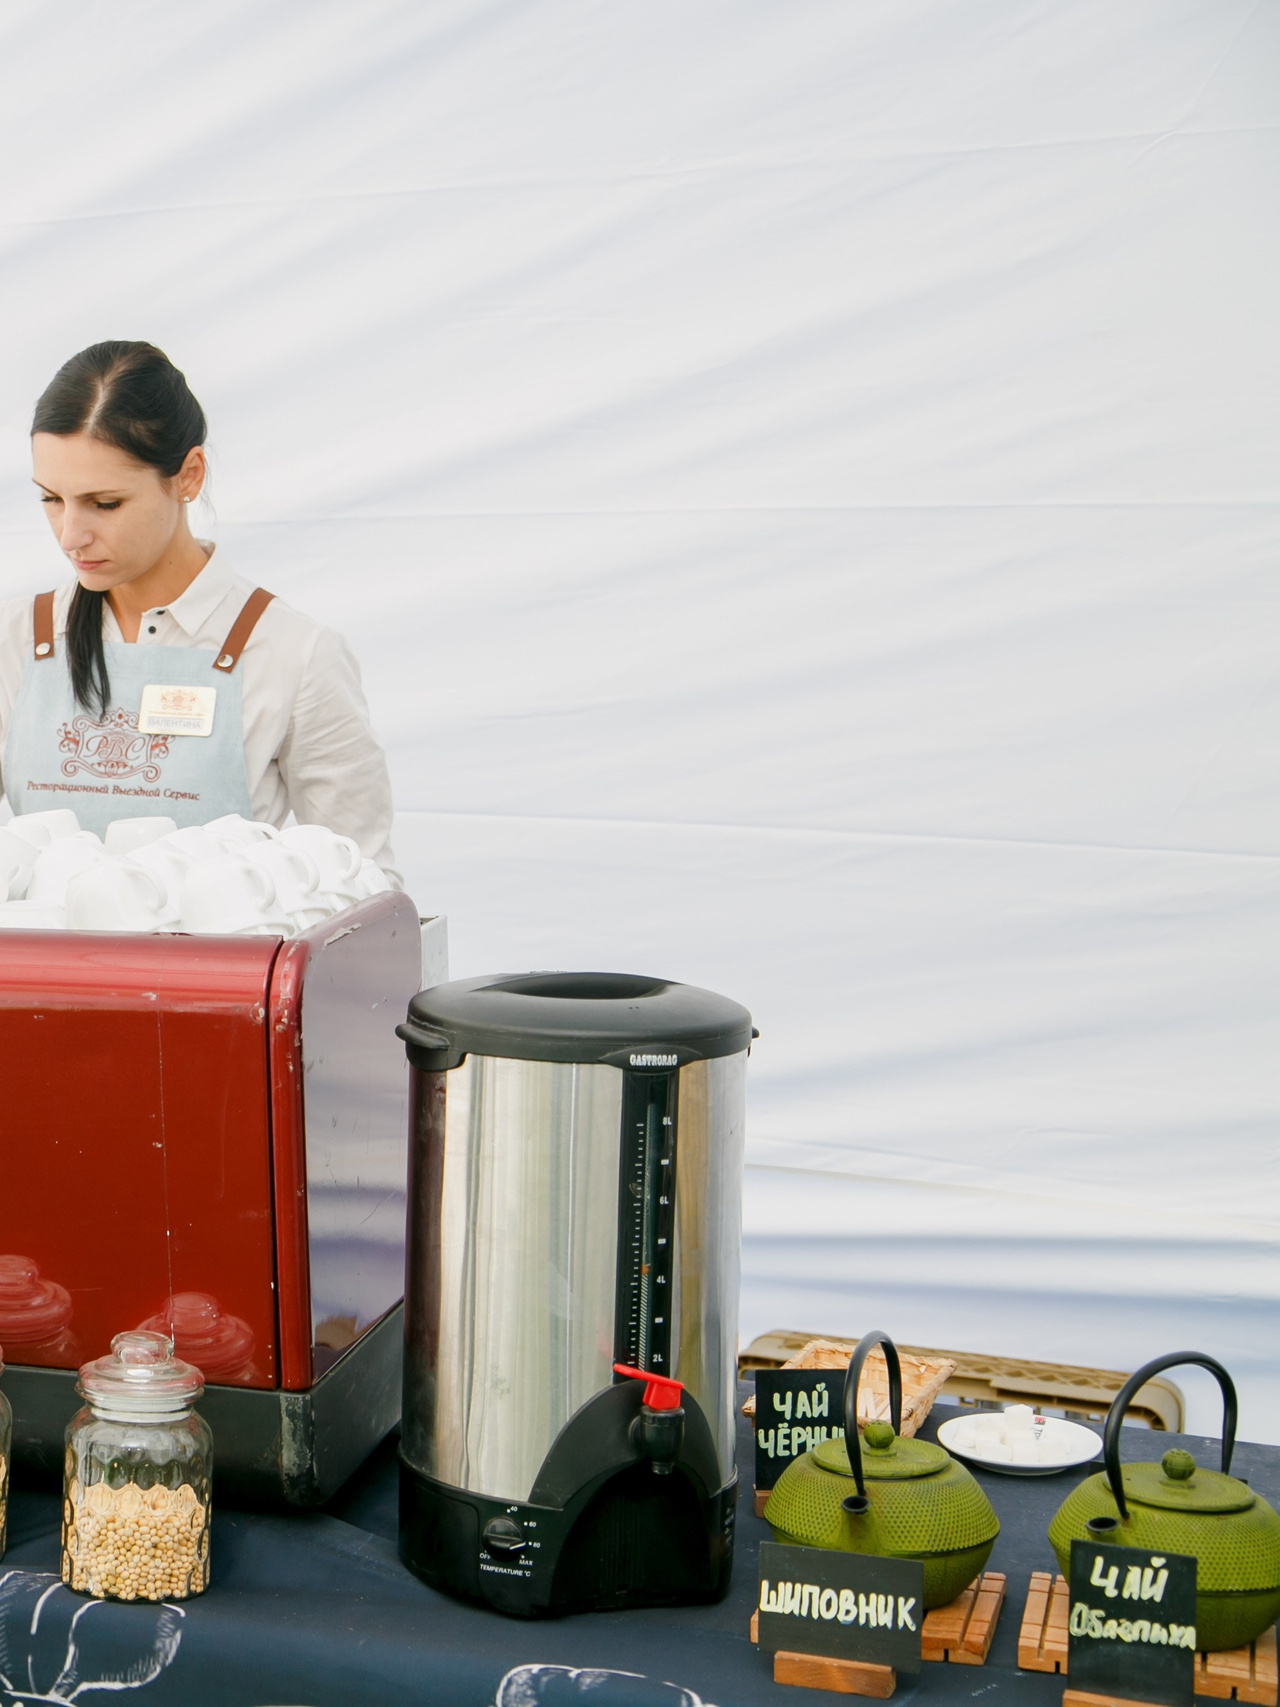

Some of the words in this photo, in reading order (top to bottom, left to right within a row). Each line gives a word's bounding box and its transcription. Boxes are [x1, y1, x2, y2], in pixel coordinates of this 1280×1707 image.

[26, 780, 110, 795] Ресторационный
[112, 784, 161, 798] Выездной
[163, 788, 201, 802] Сервис
[630, 1054, 678, 1066] GASTRORAG
[662, 1116, 672, 1125] 8L
[659, 1195, 669, 1206] 6L
[656, 1274, 667, 1284] 4L
[652, 1353, 664, 1363] 2L
[772, 1381, 830, 1421] ЧАЙ
[757, 1422, 846, 1459] ЧЁРН
[480, 1564, 523, 1576] TEMPERATURE
[1089, 1555, 1170, 1603] ЧАЙ
[759, 1578, 918, 1633] ШИПОВНИК
